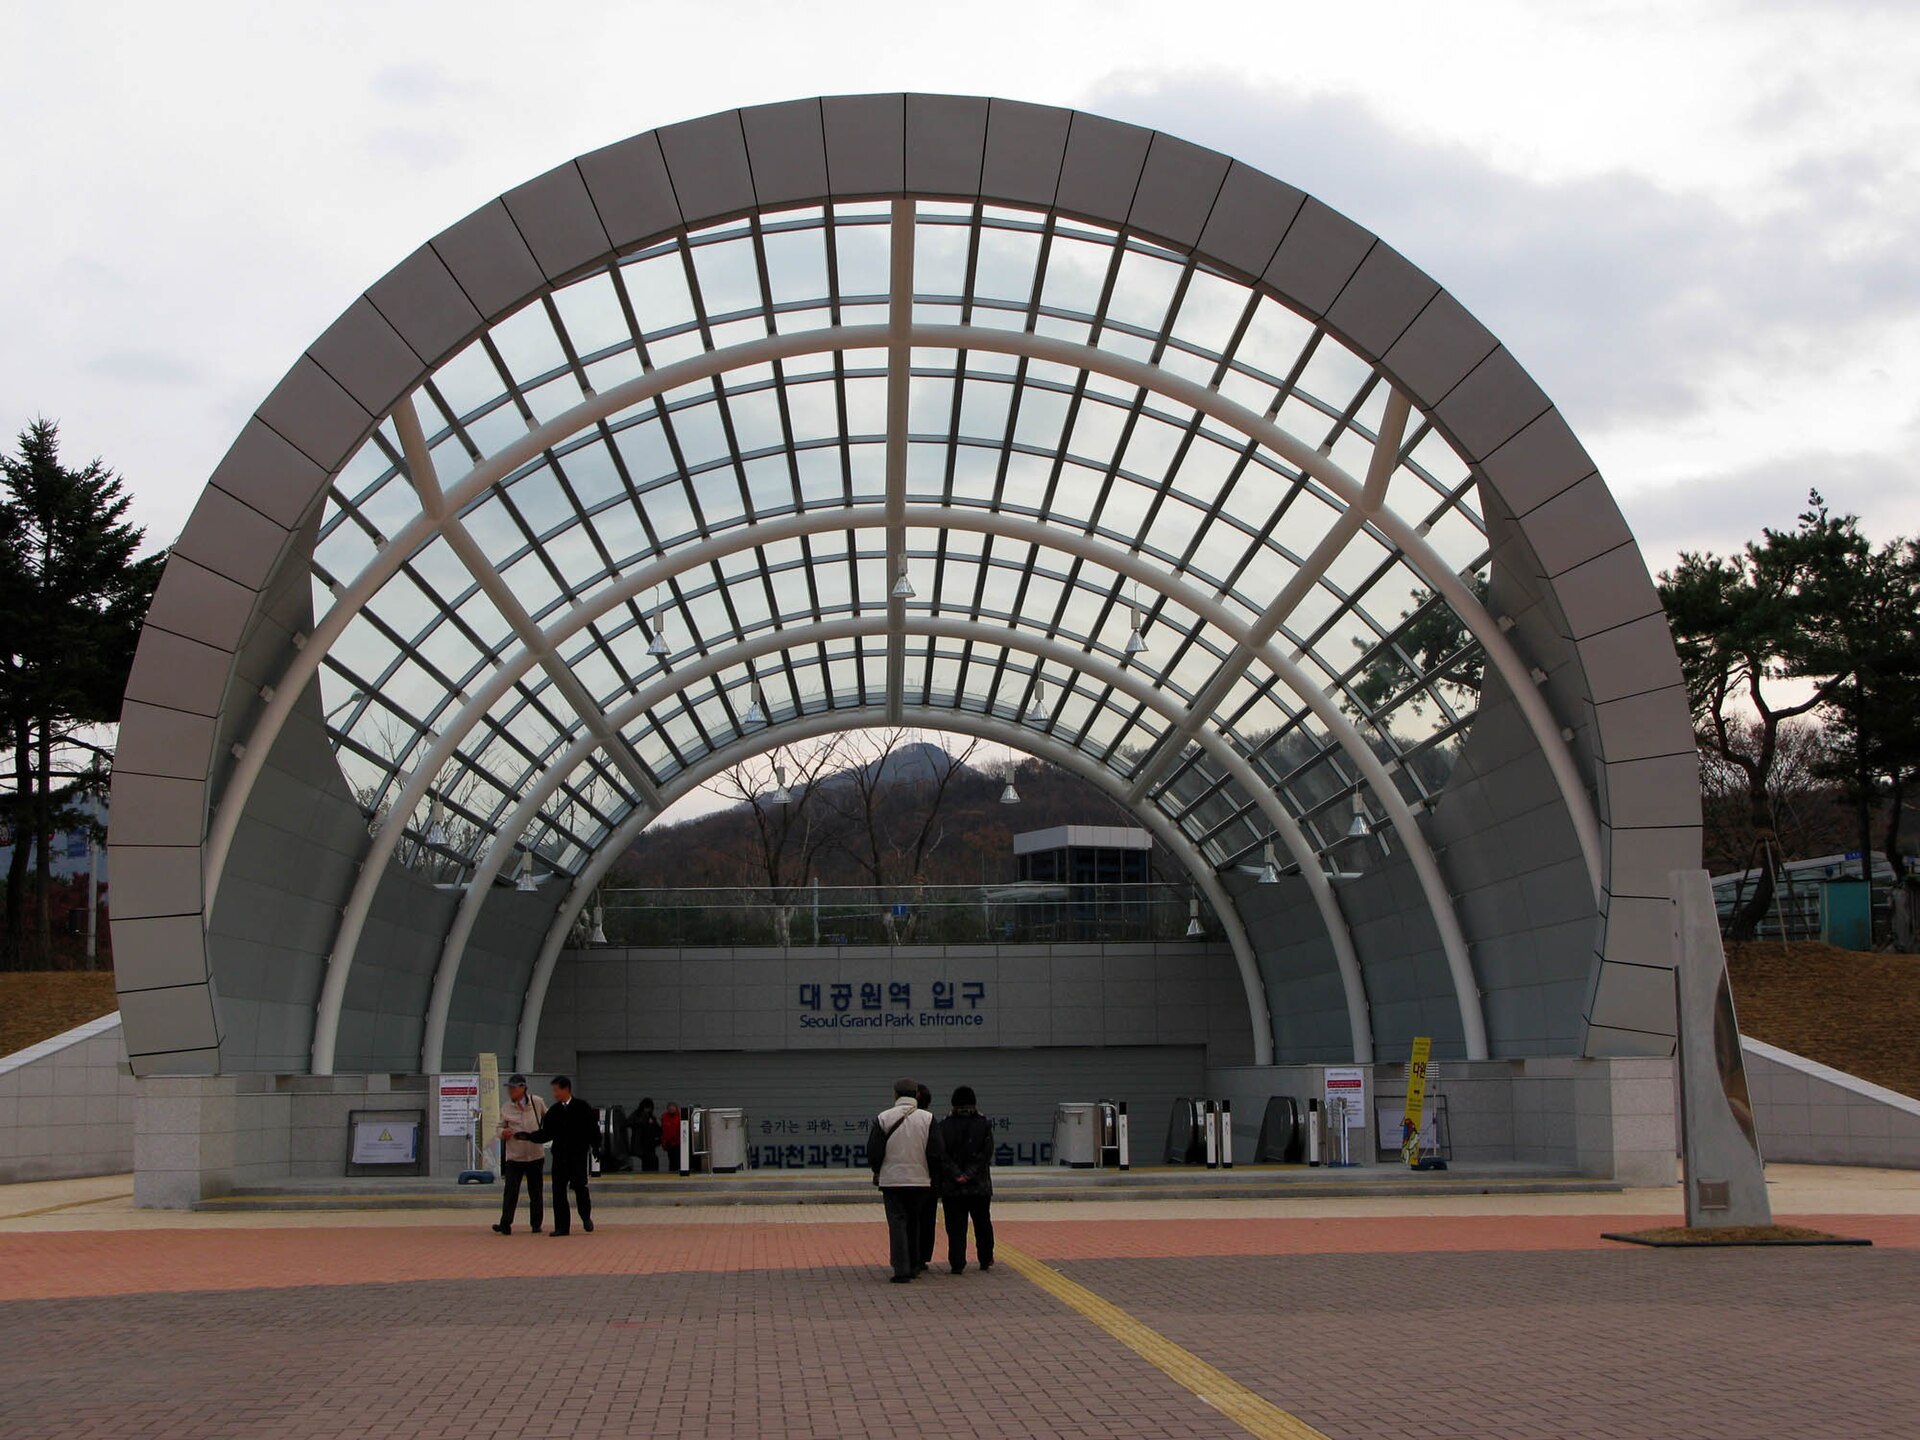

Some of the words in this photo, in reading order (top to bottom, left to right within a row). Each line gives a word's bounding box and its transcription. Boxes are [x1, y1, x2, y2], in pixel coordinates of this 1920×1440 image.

[799, 982, 910, 1011] 대공원역
[931, 981, 985, 1009] 입구
[800, 1014, 838, 1028] Seoul
[840, 1014, 882, 1028] Grand
[885, 1013, 914, 1026] Park
[920, 1013, 983, 1026] Entrance
[760, 1119, 799, 1134] 즐기는
[843, 1119, 873, 1133] 느끼
